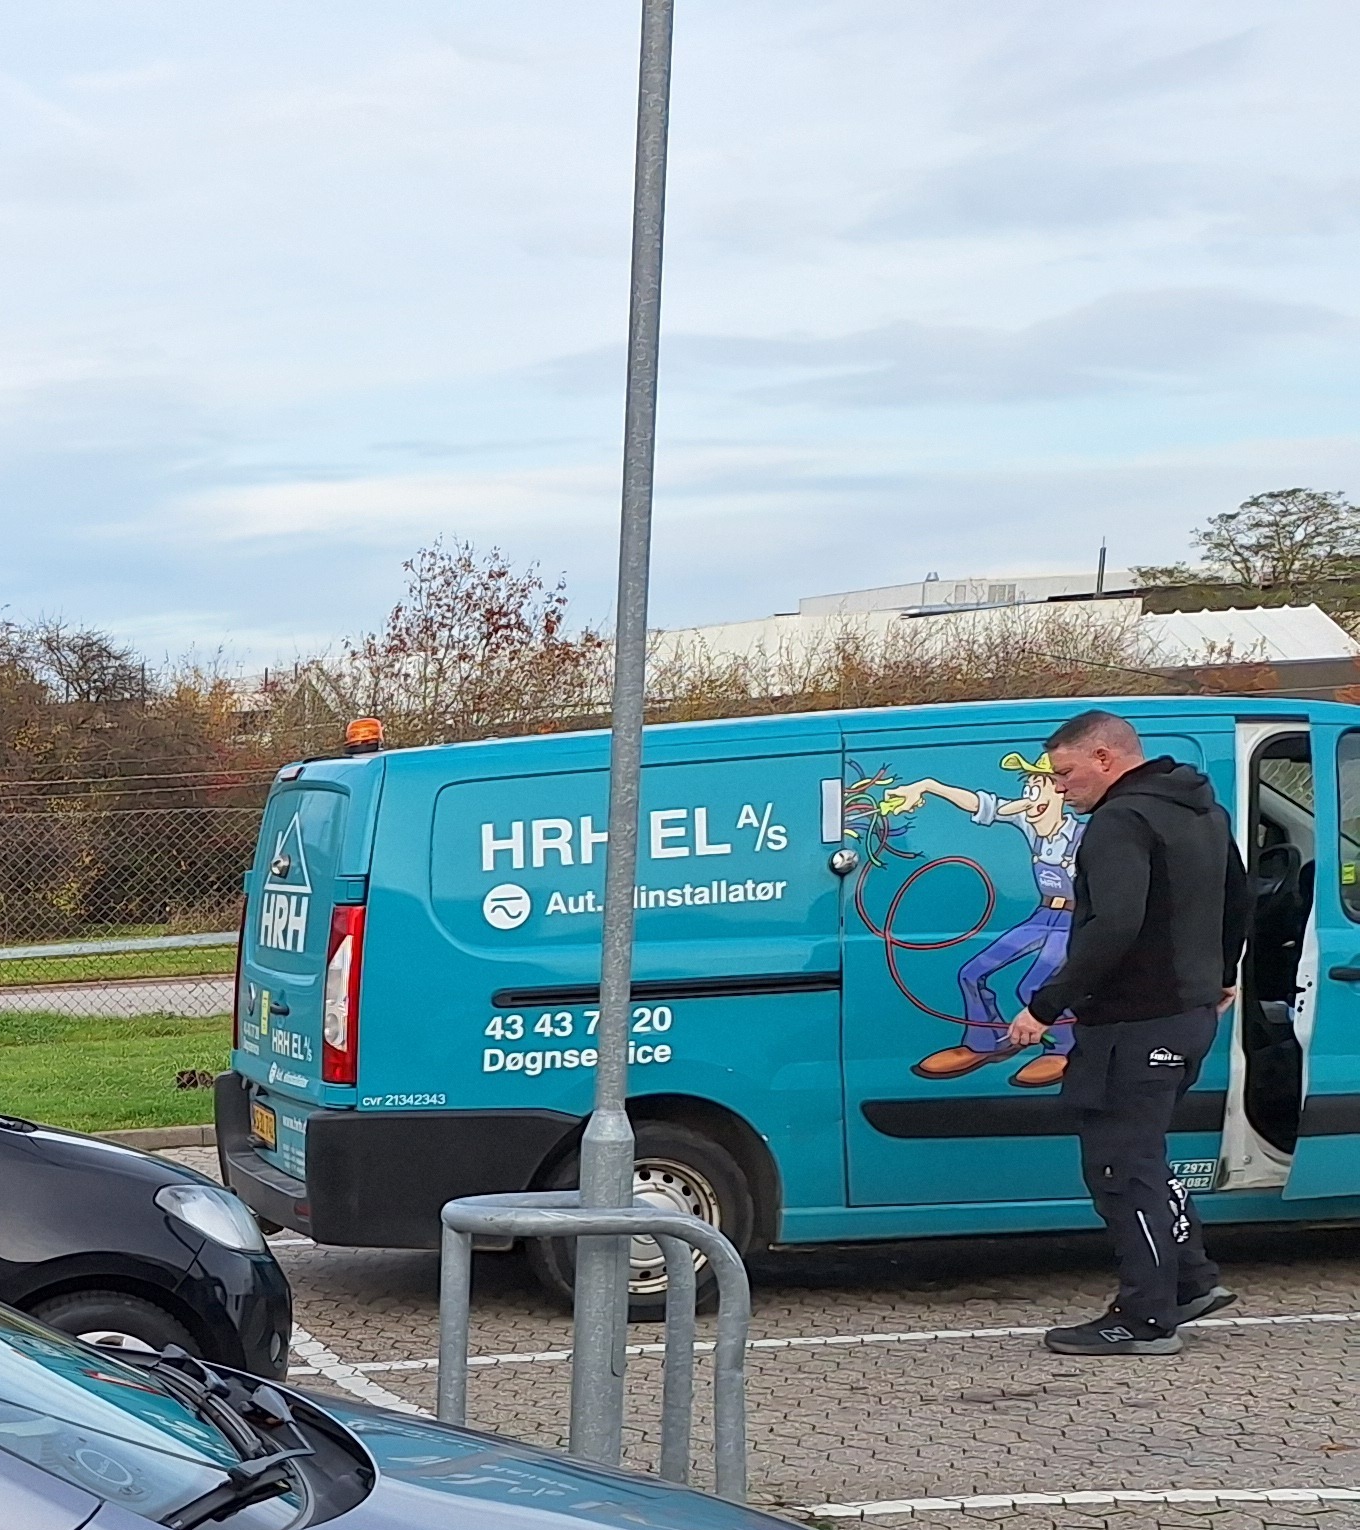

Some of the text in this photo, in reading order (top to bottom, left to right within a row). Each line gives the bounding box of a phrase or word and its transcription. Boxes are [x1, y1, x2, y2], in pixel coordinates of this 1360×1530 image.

[481, 815, 609, 871] HRH
[650, 806, 732, 859] EL
[544, 879, 787, 916] Aut. linstallatør
[260, 892, 309, 953] HRH
[484, 1014, 524, 1041] 43
[533, 1011, 573, 1038] 43
[632, 1006, 672, 1033] 20
[271, 1027, 290, 1057] HRH
[292, 1032, 305, 1061] EL
[483, 1040, 672, 1076] Døgnseice
[362, 1093, 447, 1106] cvr 21342343
[1183, 1162, 1212, 1174] 2973
